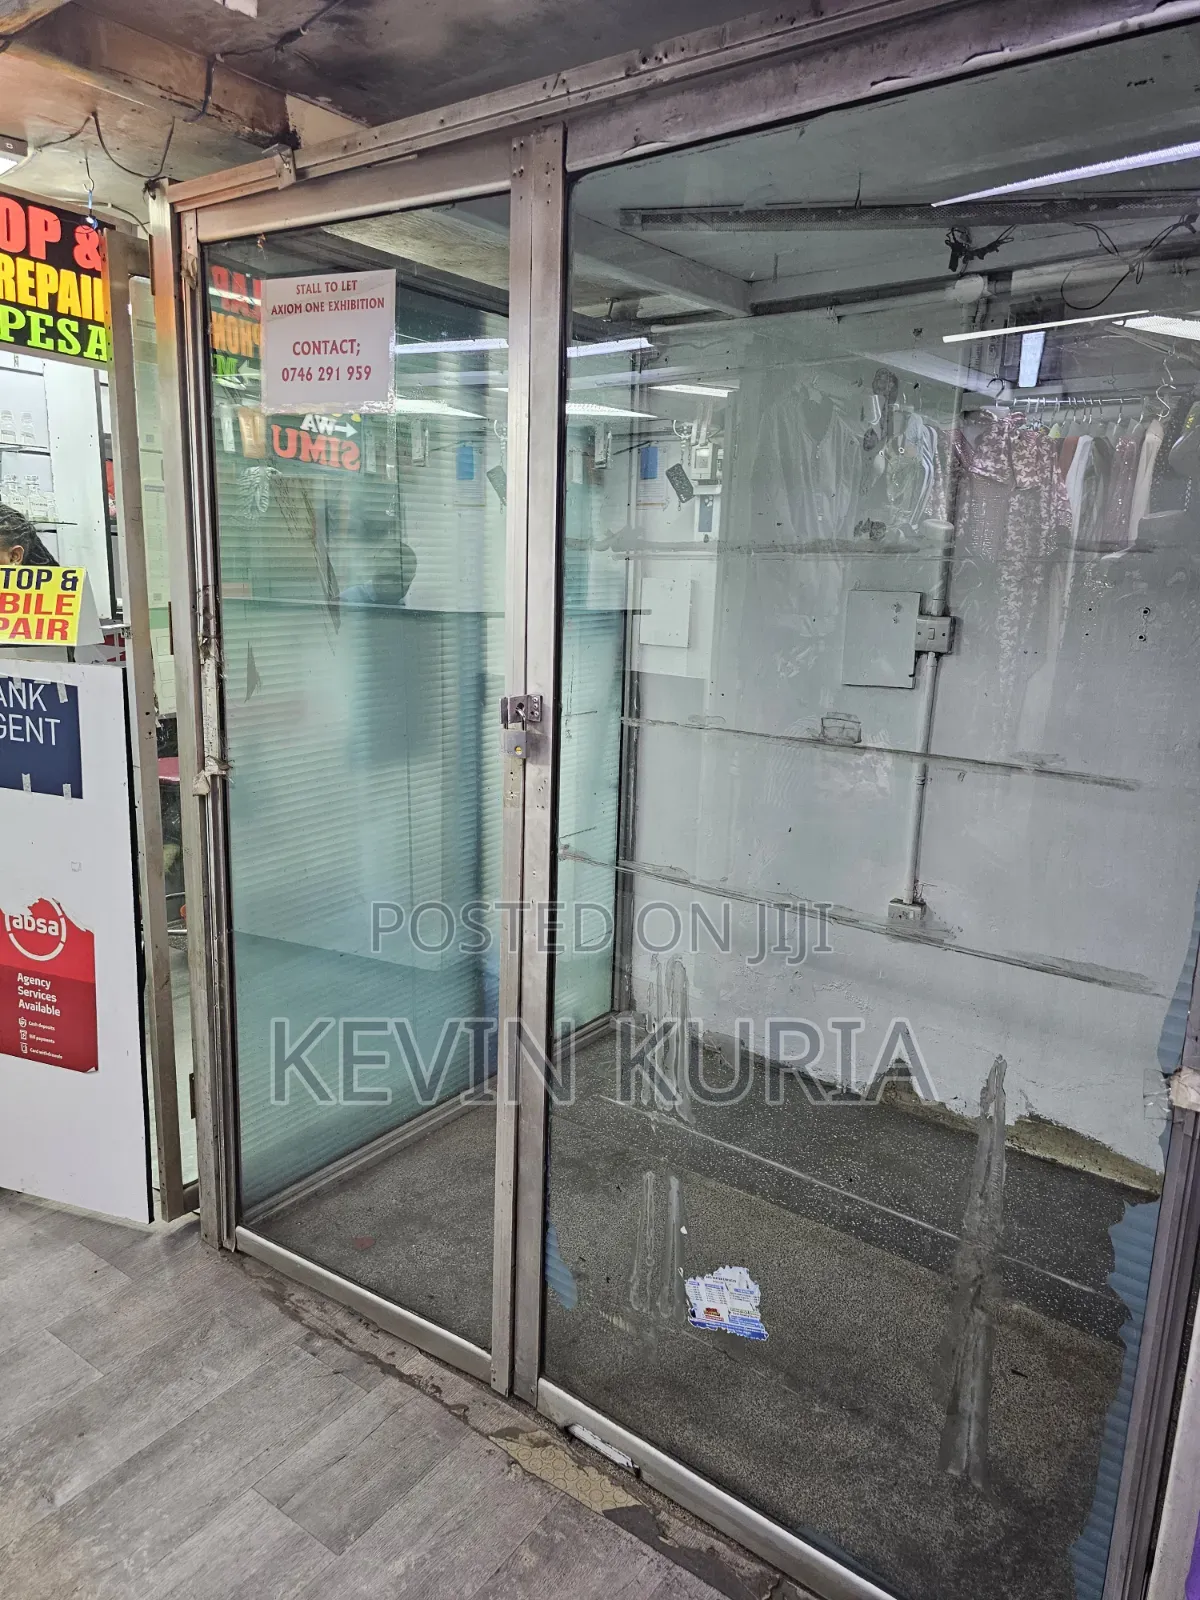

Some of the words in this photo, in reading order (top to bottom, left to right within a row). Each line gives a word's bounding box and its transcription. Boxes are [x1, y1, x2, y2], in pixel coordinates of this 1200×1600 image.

[296, 281, 321, 295] STALL
[325, 281, 338, 293] TO
[341, 280, 358, 292] LET
[271, 303, 302, 316] AXIOM
[305, 301, 325, 313] ONE
[328, 297, 385, 312] EXHIBITION
[292, 339, 361, 356] CONTACT;
[281, 367, 313, 382] 0746
[318, 366, 341, 381] 291
[347, 365, 372, 381] 959
[0, 568, 53, 591] TOP
[60, 570, 79, 592] &
[0, 592, 76, 616] BILE
[12, 914, 60, 936] absa
[17, 972, 51, 990] Agency
[17, 986, 57, 1003] Services
[18, 999, 61, 1017] Available
